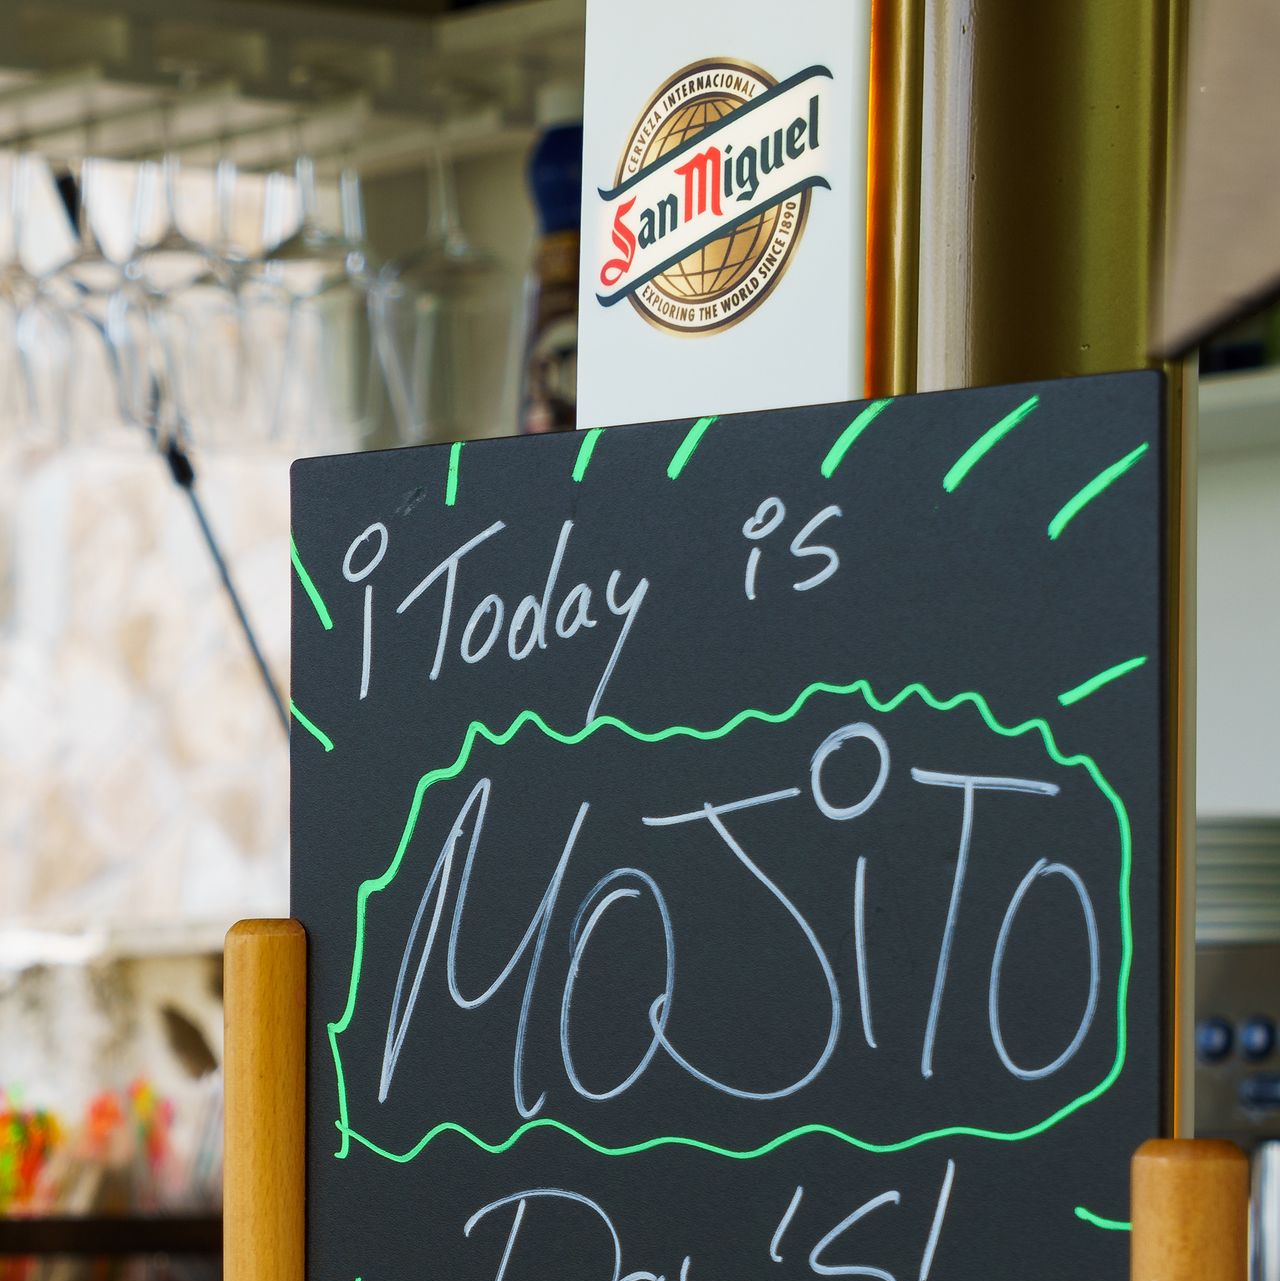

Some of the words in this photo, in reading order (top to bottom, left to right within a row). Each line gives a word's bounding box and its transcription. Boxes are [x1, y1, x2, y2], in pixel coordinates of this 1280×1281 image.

[627, 111, 662, 174] CERVEZA
[663, 73, 756, 112] INTERNACIONAL
[600, 195, 678, 287] San
[674, 94, 820, 223] Miguel
[642, 285, 695, 322] EXPLORING
[699, 303, 718, 321] THE
[720, 278, 760, 313] WORLD
[758, 238, 786, 279] SINCE
[781, 201, 797, 236] 1890
